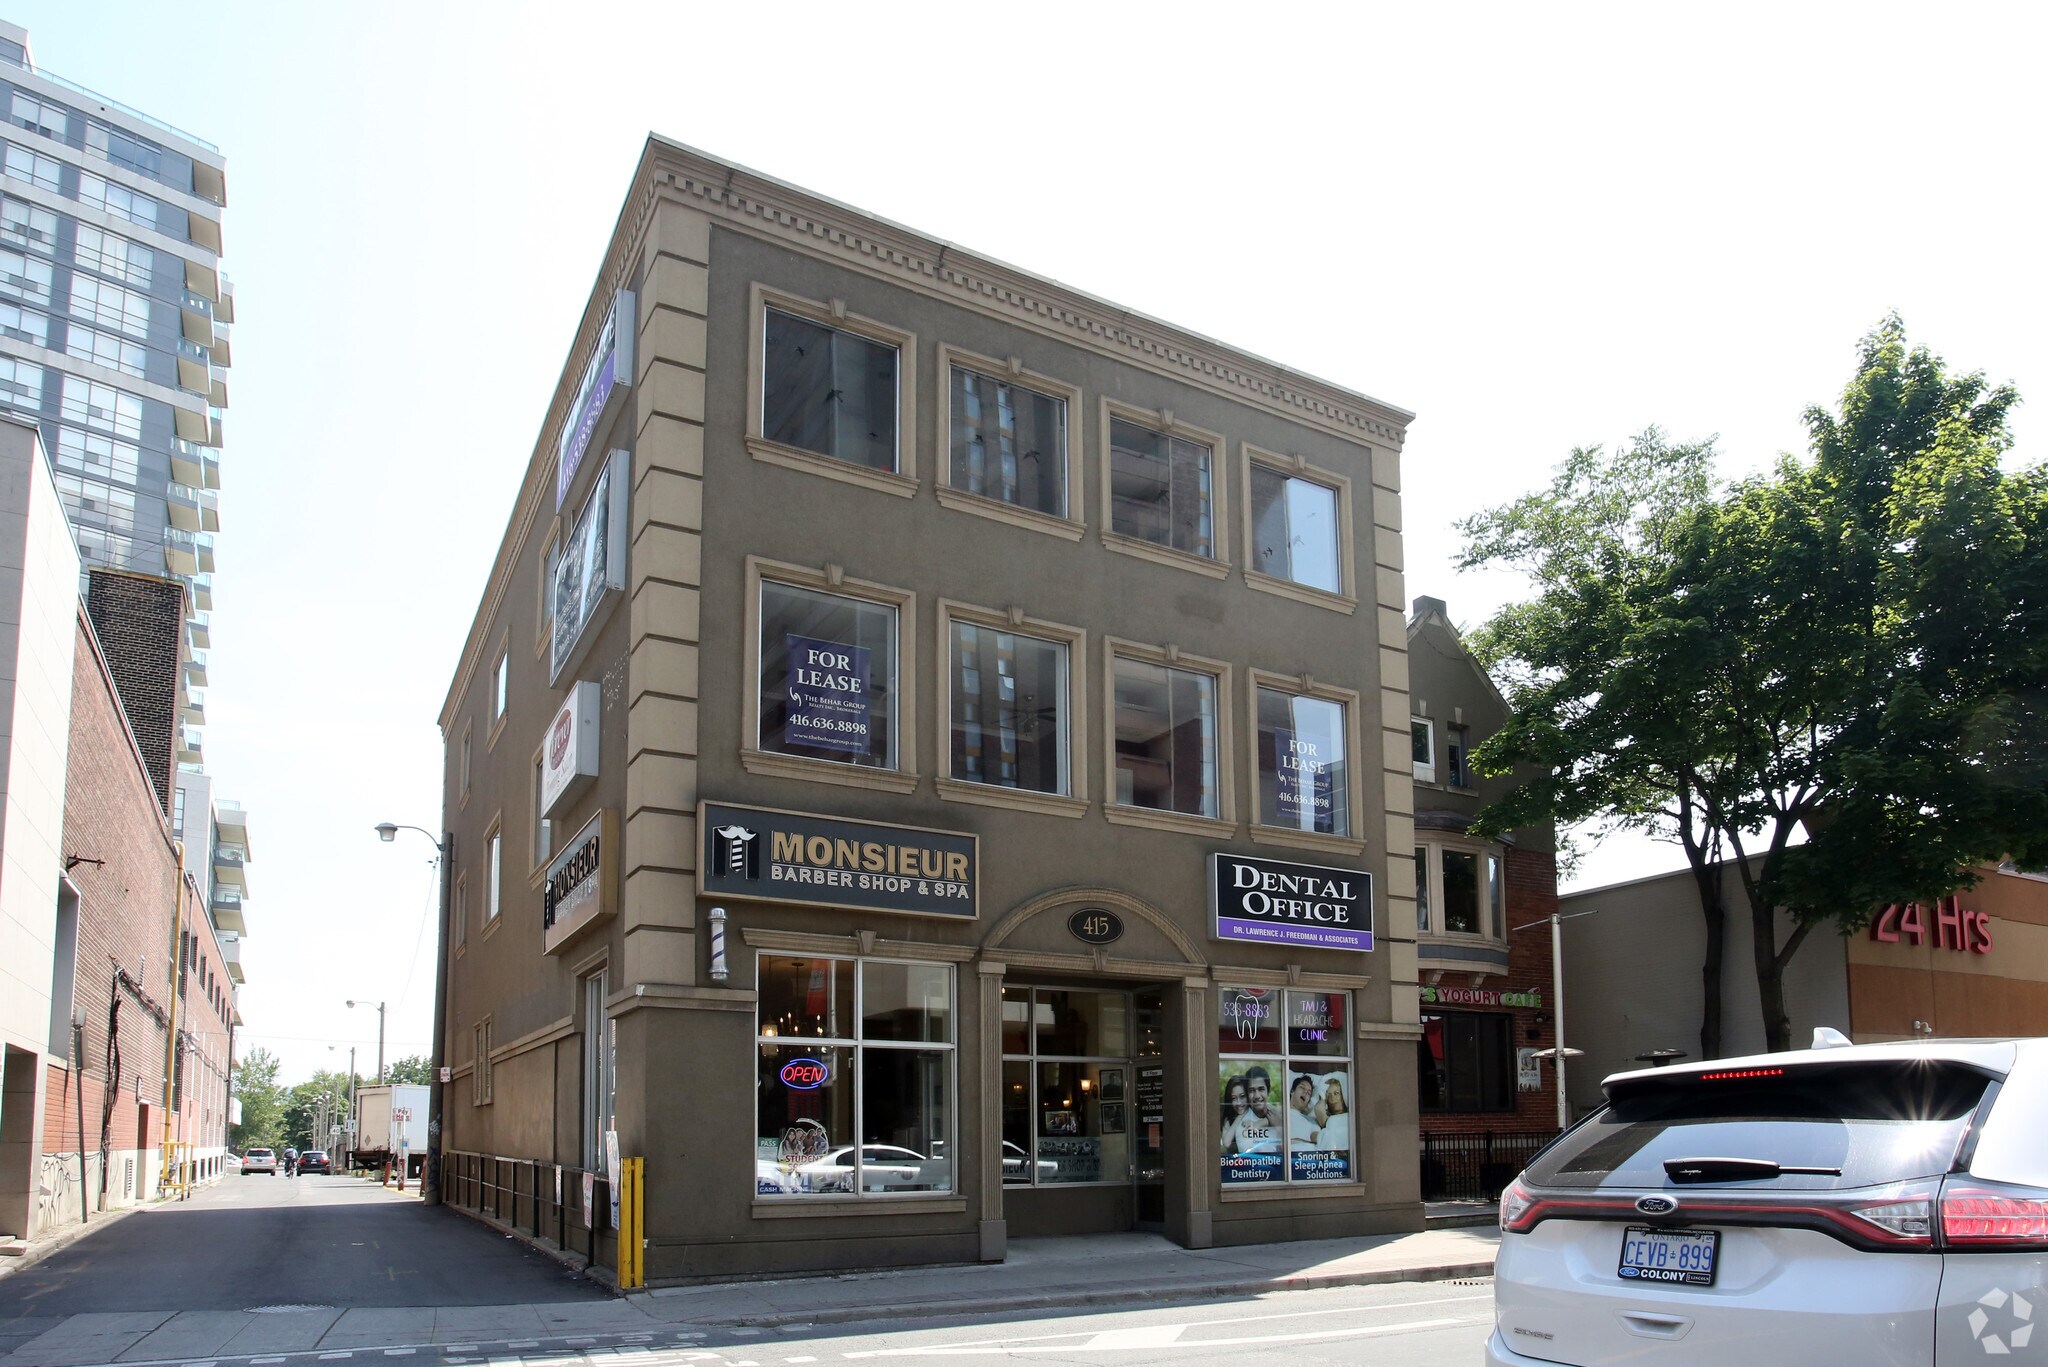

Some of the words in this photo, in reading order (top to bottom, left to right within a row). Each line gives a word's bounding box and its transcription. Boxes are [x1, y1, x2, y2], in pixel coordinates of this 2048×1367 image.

[808, 649, 851, 671] FOR
[797, 668, 861, 693] LEASE
[805, 694, 818, 703] THE
[820, 697, 841, 707] BEHAR
[843, 701, 866, 710] GROUP
[789, 714, 867, 735] 416.636.8898
[1289, 739, 1317, 756] FOR
[1282, 755, 1325, 774] LEASE
[771, 830, 970, 882] MONSIEUR
[554, 836, 598, 903] MONSIEUR
[771, 866, 853, 888] BARBER
[859, 874, 911, 893] SHOP
[917, 881, 929, 895] &
[934, 882, 969, 899] SPA
[1232, 863, 1357, 901] DENTAL
[1242, 891, 1349, 923] OFFICE
[1083, 916, 1109, 936] 415
[1937, 895, 1993, 954] Hrs
[1233, 926, 1245, 934] DR.
[1246, 927, 1278, 938] LAWRENCE
[1280, 930, 1286, 938] J.
[1286, 931, 1318, 941] FREEDMAN
[1319, 934, 1324, 942] &
[1325, 934, 1358, 945] ASSOCIATES
[1441, 988, 1500, 1005] YOGURT
[1223, 1001, 1270, 1019] 538-8883
[1300, 1000, 1319, 1012] TMJ
[1320, 1000, 1328, 1012] &
[1293, 1014, 1334, 1027] HEADACHE
[1300, 1028, 1328, 1041] CLINIC
[783, 1066, 823, 1082] OPEN
[1242, 1129, 1269, 1138] CEREC
[786, 1154, 823, 1163] STUDENT
[1220, 1156, 1281, 1168] Biocompatible
[1297, 1152, 1328, 1162] Snoring
[1330, 1151, 1337, 1160] &
[1295, 1160, 1316, 1171] Sleep
[1318, 1160, 1343, 1170] Apnea
[1231, 1169, 1271, 1180] Dentistry
[1306, 1169, 1343, 1180] Solutions
[1643, 1199, 1666, 1211] Ford
[1652, 1234, 1689, 1242] ONTARIO
[1625, 1241, 1668, 1267] CEVB
[1679, 1244, 1712, 1271] 899
[1640, 1269, 1686, 1281] COLONY
